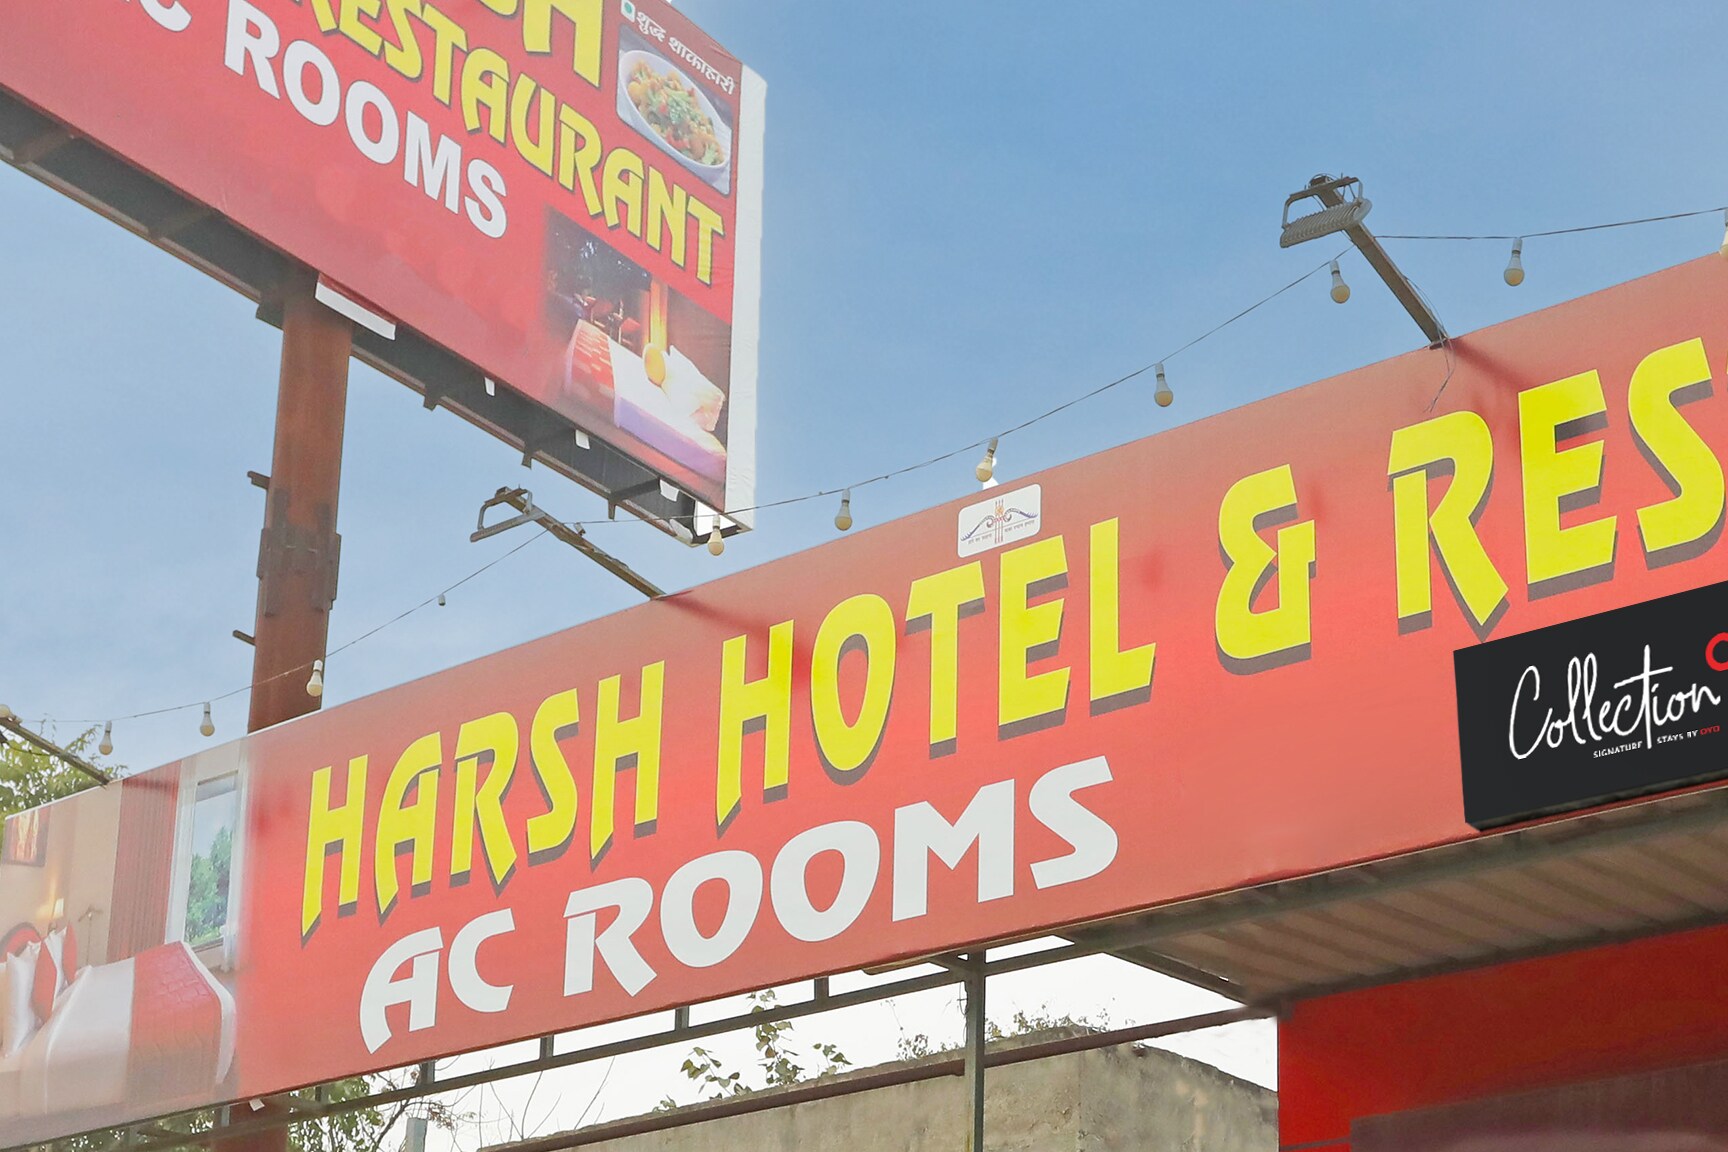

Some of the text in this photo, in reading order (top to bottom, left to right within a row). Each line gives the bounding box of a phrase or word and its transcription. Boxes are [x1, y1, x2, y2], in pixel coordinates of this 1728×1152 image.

[223, 0, 509, 240] ROOMS
[668, 36, 736, 95] शाकाहारी
[300, 664, 664, 946] HARSH
[716, 516, 1157, 830] HOTEL
[1214, 465, 1318, 672] &
[1508, 644, 1721, 760] Collection
[1593, 725, 1720, 759] SIGNATURE STAYS BY OYO
[359, 755, 1119, 1054] AC ROOMS
